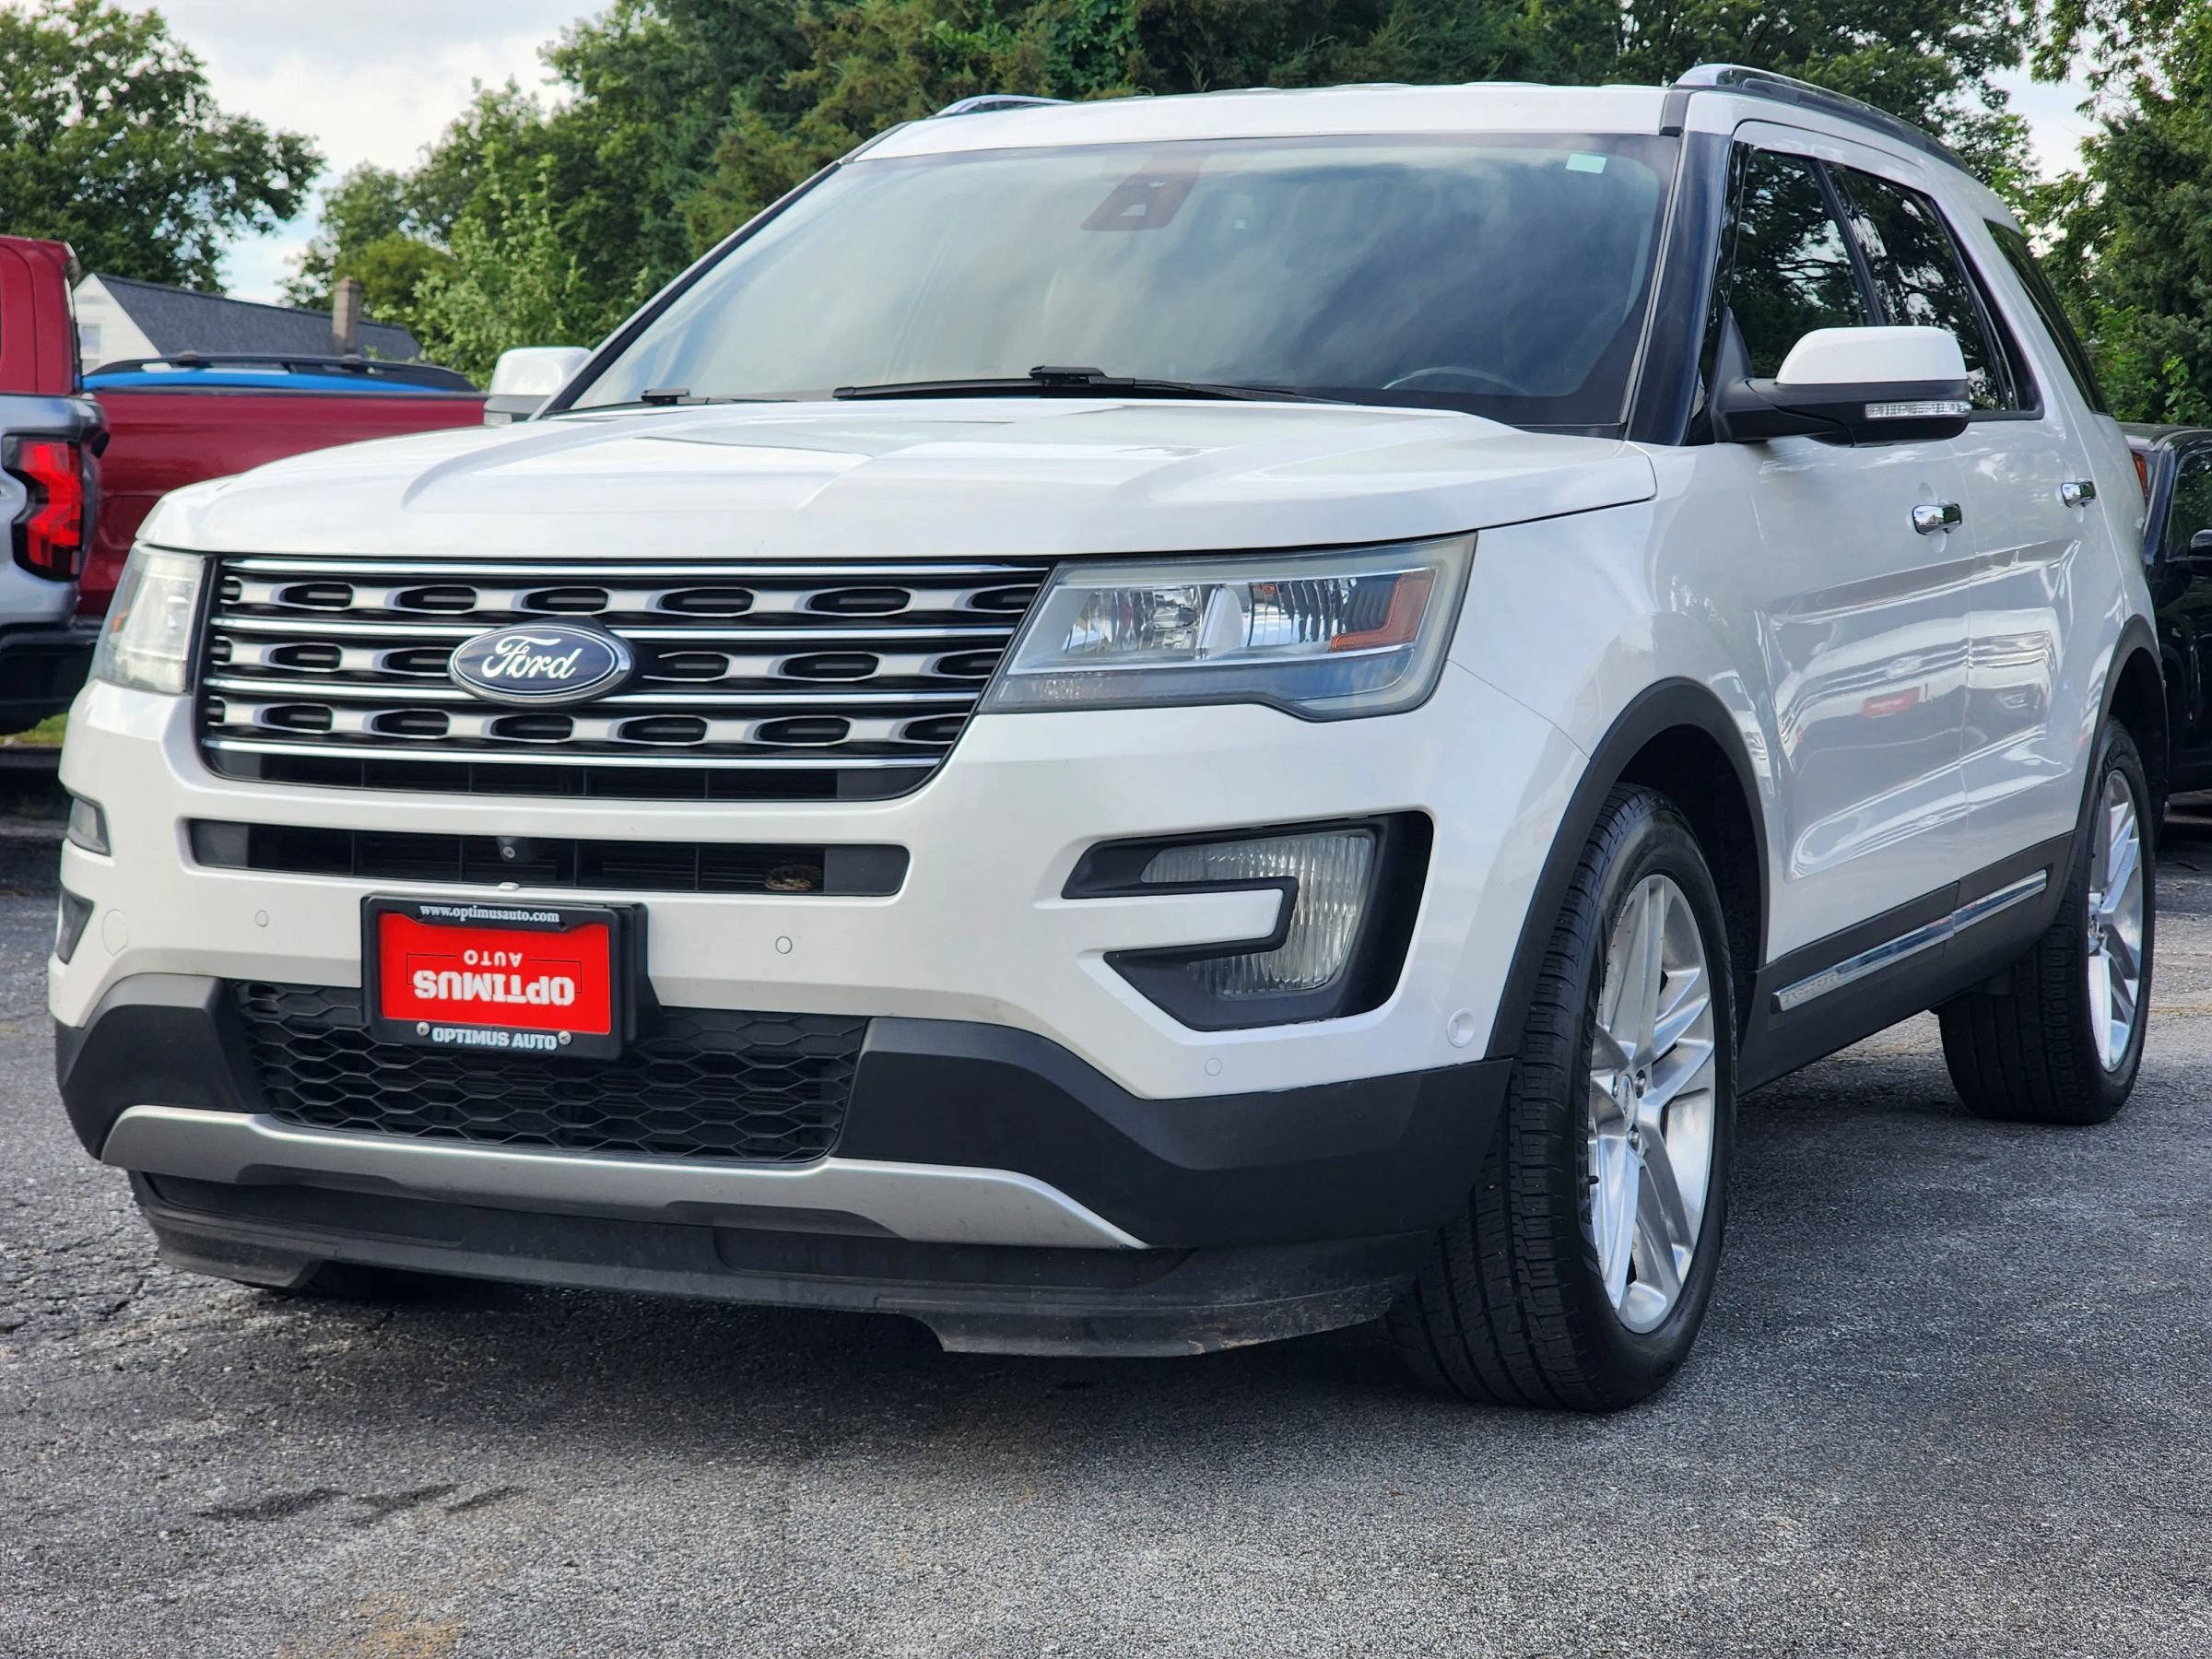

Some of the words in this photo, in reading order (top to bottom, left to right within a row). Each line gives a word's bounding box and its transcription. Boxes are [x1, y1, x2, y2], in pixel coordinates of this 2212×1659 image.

[481, 635, 583, 679] Ford
[419, 904, 559, 923] www.optimusauto.com
[464, 949, 523, 968] AUTO
[413, 970, 575, 1006] OPTIMUS
[432, 1027, 509, 1047] OPTIMUS
[512, 1033, 558, 1051] AUTO
